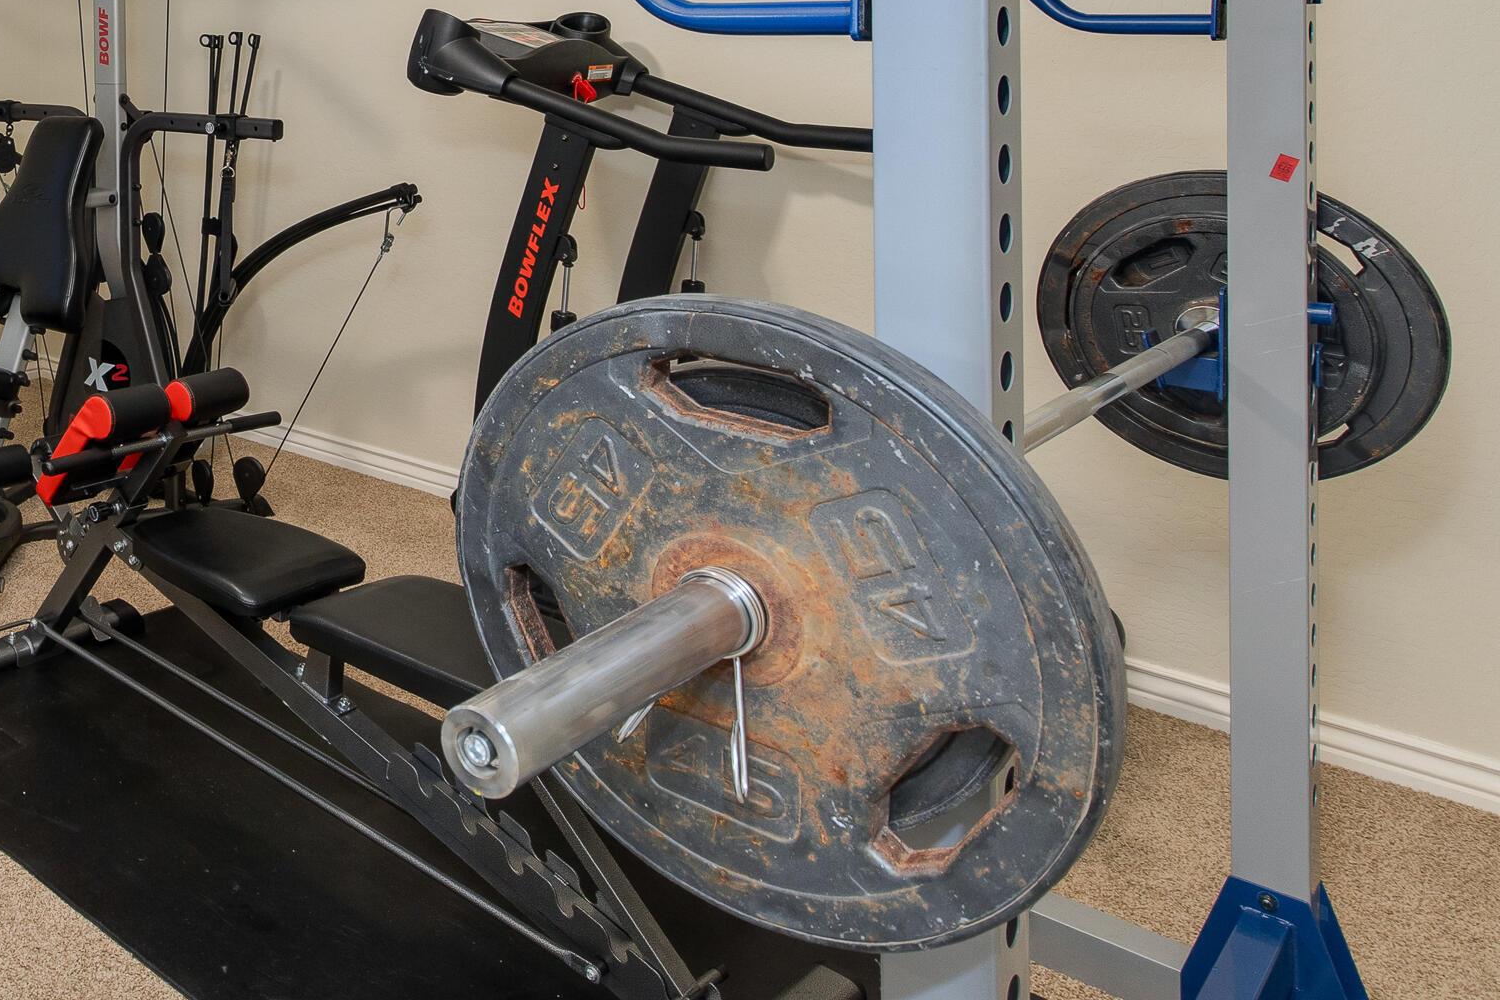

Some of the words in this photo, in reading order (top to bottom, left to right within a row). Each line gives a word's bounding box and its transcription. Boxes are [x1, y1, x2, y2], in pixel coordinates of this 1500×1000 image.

[507, 176, 560, 319] BOWFLEX
[547, 433, 623, 544] 45
[828, 505, 948, 642] 45
